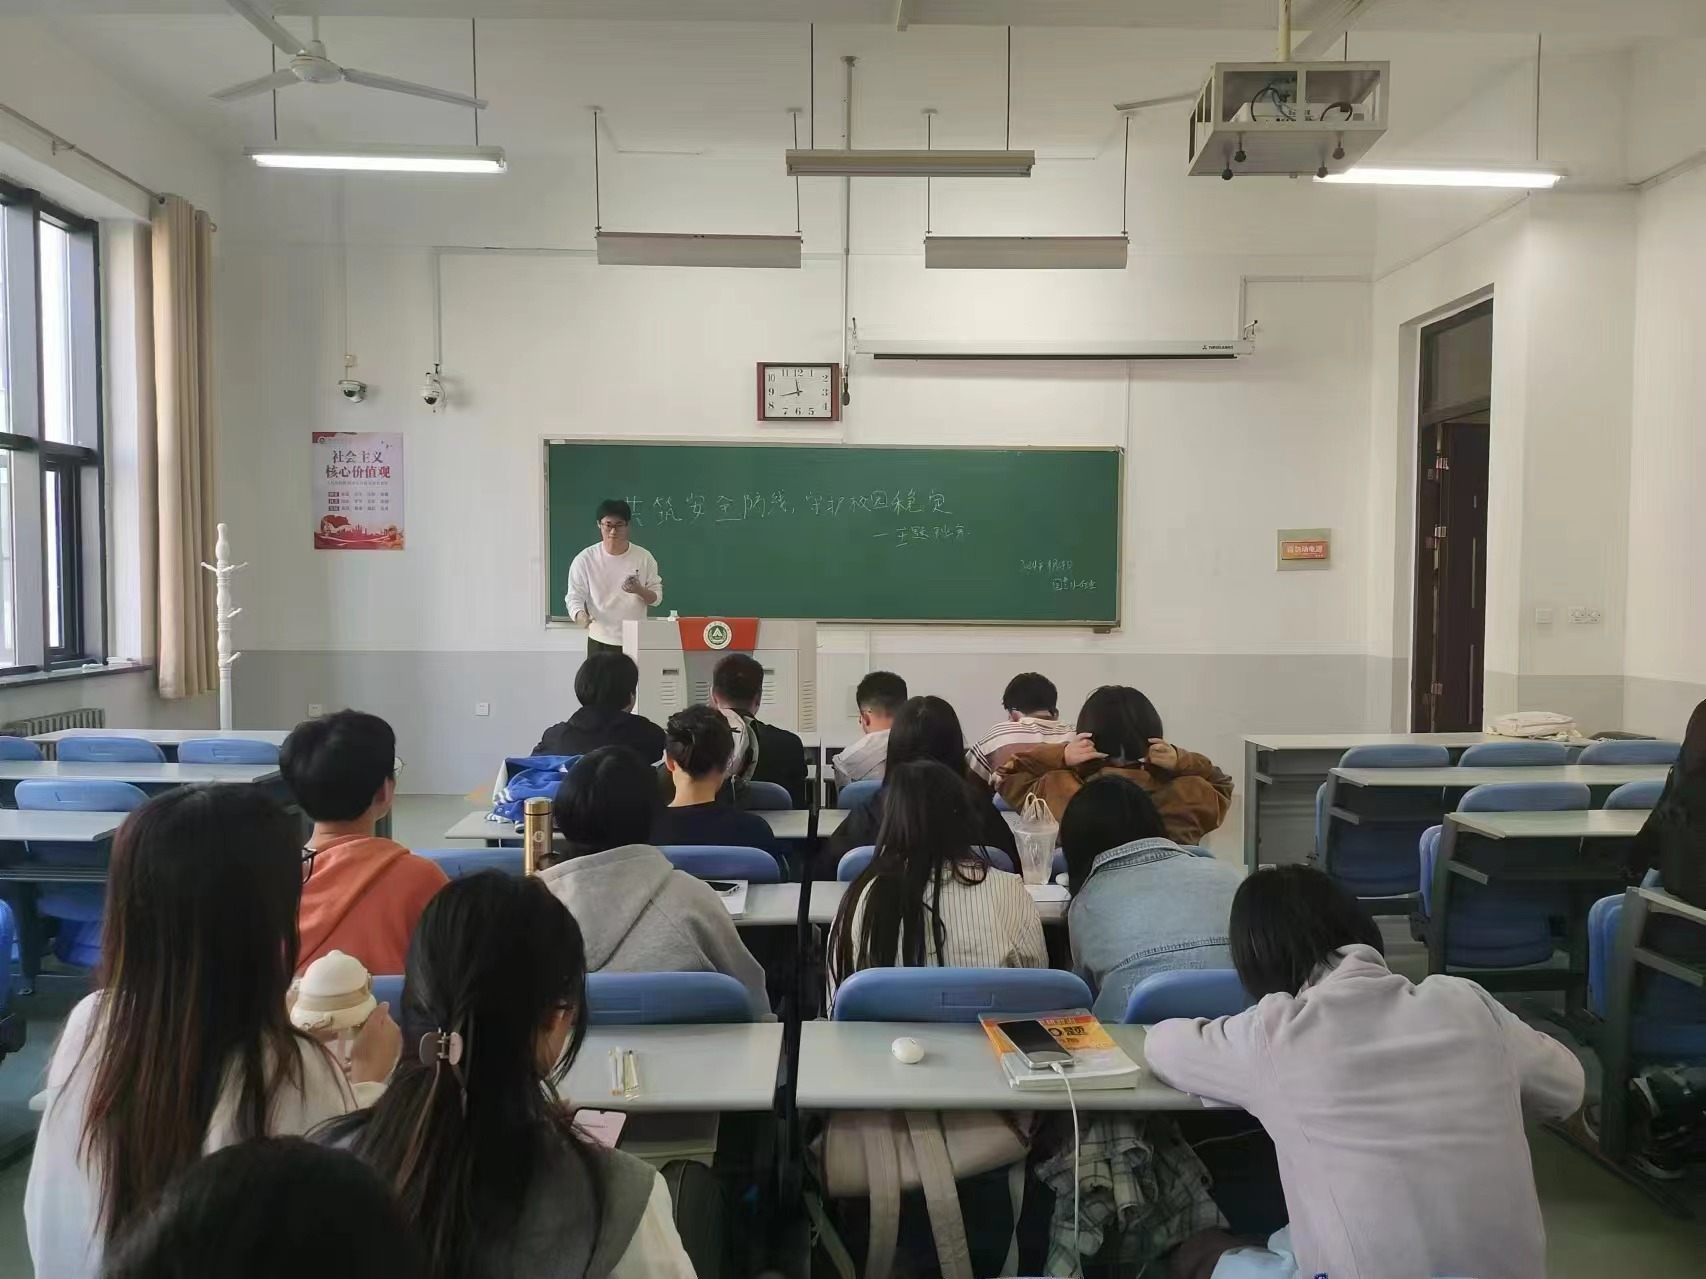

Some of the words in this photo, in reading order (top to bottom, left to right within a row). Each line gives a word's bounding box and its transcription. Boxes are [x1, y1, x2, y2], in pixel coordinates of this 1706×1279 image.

[332, 450, 384, 464] 社会主义
[325, 464, 391, 479] 核心价值观
